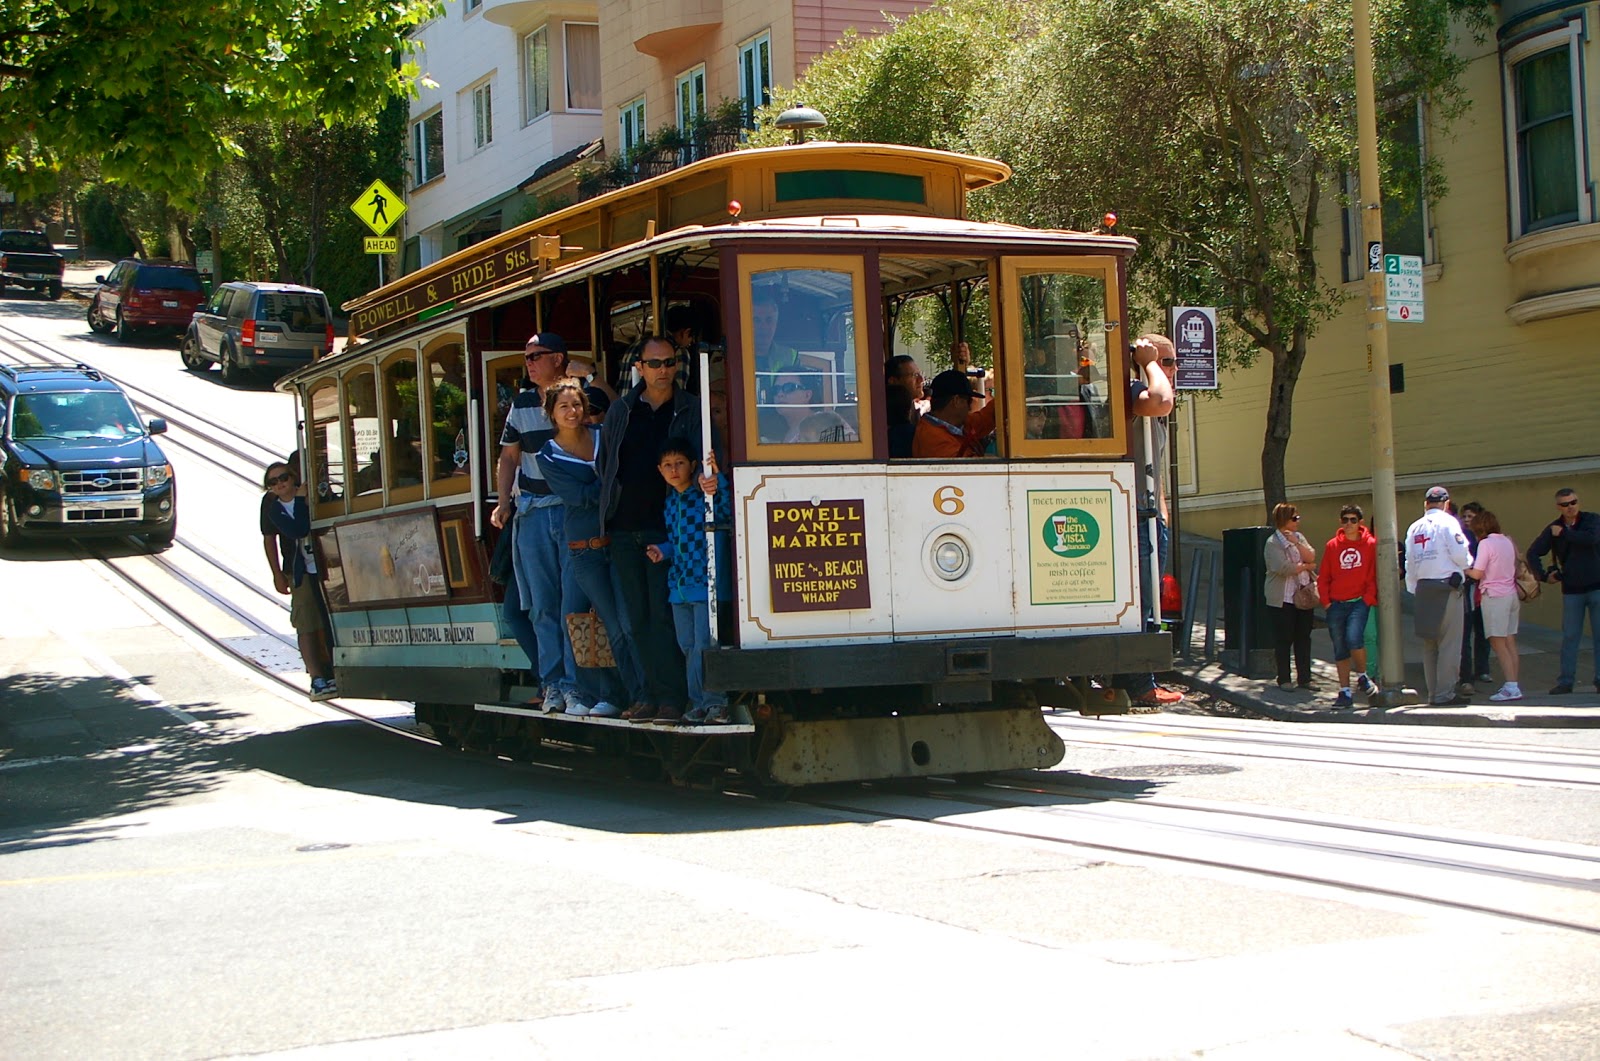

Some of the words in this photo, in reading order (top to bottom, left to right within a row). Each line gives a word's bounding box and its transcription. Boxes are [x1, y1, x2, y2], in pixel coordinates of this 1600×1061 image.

[366, 240, 396, 250] AHEAD
[1388, 258, 1397, 272] 2
[1404, 260, 1419, 268] HOUR
[1400, 269, 1421, 277] PARKING
[358, 296, 415, 330] POWELL
[426, 284, 439, 303] &
[452, 260, 496, 294] HYDE
[505, 249, 529, 272] Sts.
[933, 485, 965, 515] 6
[1033, 497, 1054, 505] meet
[1080, 496, 1094, 504] the
[773, 507, 860, 522] POWELL
[1066, 515, 1078, 523] the
[797, 522, 840, 532] AND
[772, 533, 862, 548] MARKET
[775, 563, 805, 579] HYDE
[808, 563, 823, 577] AND
[825, 560, 864, 577] BEACH
[783, 579, 857, 593] FISHERMANS
[802, 591, 840, 603] WHARF
[352, 629, 366, 643] SAN
[367, 628, 403, 643] FRANCISCO
[405, 627, 442, 643] MUNICIPAL
[443, 626, 475, 642] RAILWAY
